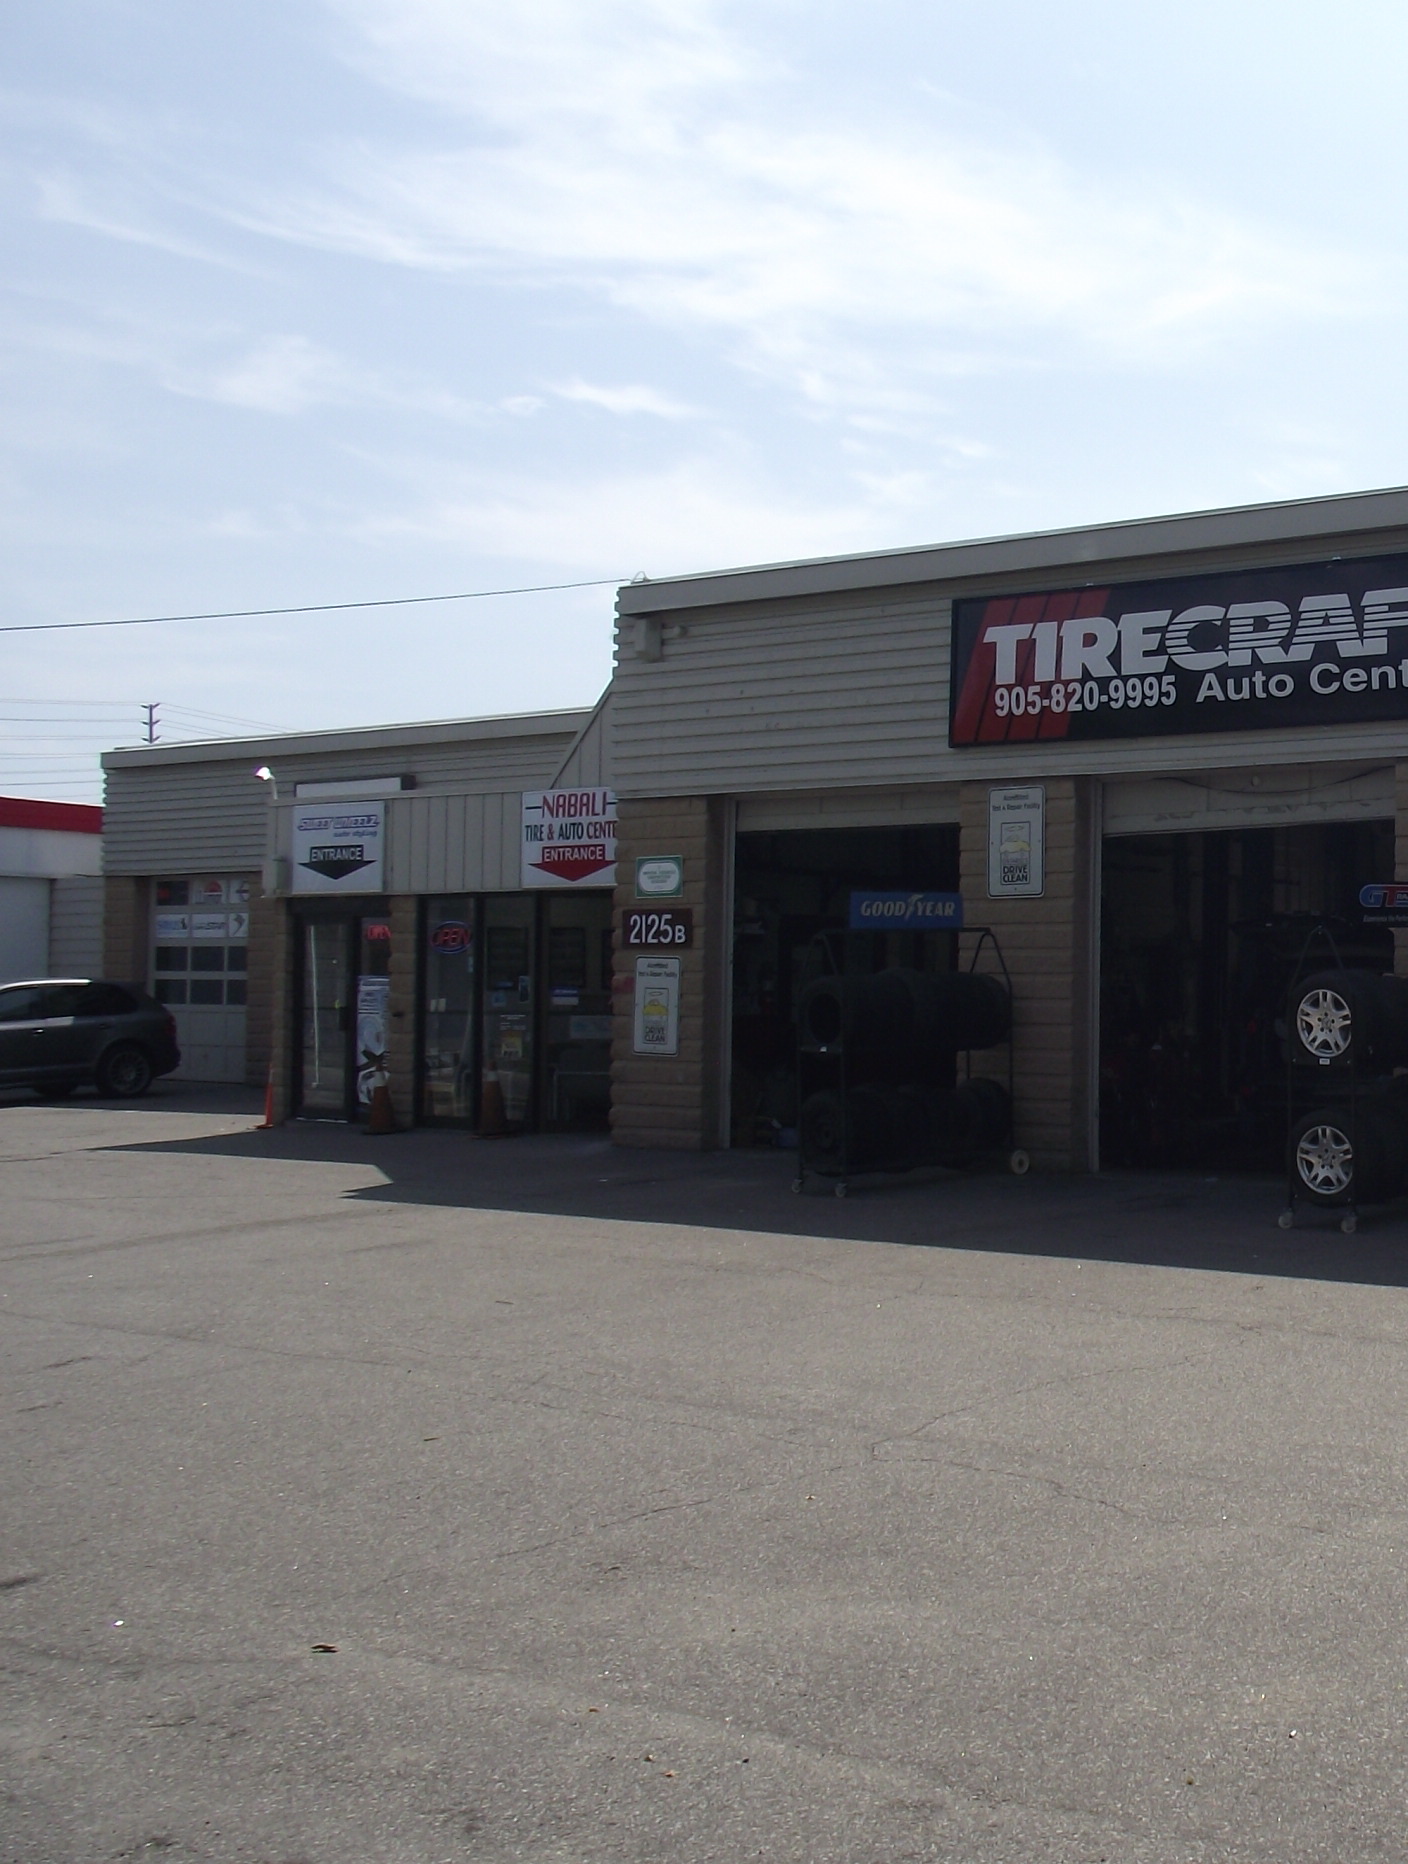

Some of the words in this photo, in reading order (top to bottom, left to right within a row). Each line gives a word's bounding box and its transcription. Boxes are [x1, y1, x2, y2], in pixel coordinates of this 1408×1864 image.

[1196, 667, 1294, 703] Auto
[995, 675, 1176, 717] 905-820-9995
[542, 791, 607, 818] NABALI
[525, 824, 544, 841] TIRE
[547, 823, 554, 840] &
[558, 822, 584, 841] AUTO
[312, 847, 362, 861] ENTRANCE
[544, 846, 604, 862] ENTRANCE
[1003, 864, 1027, 874] DRIVE
[1003, 874, 1028, 883] CLEAN
[431, 927, 471, 946] OPEN
